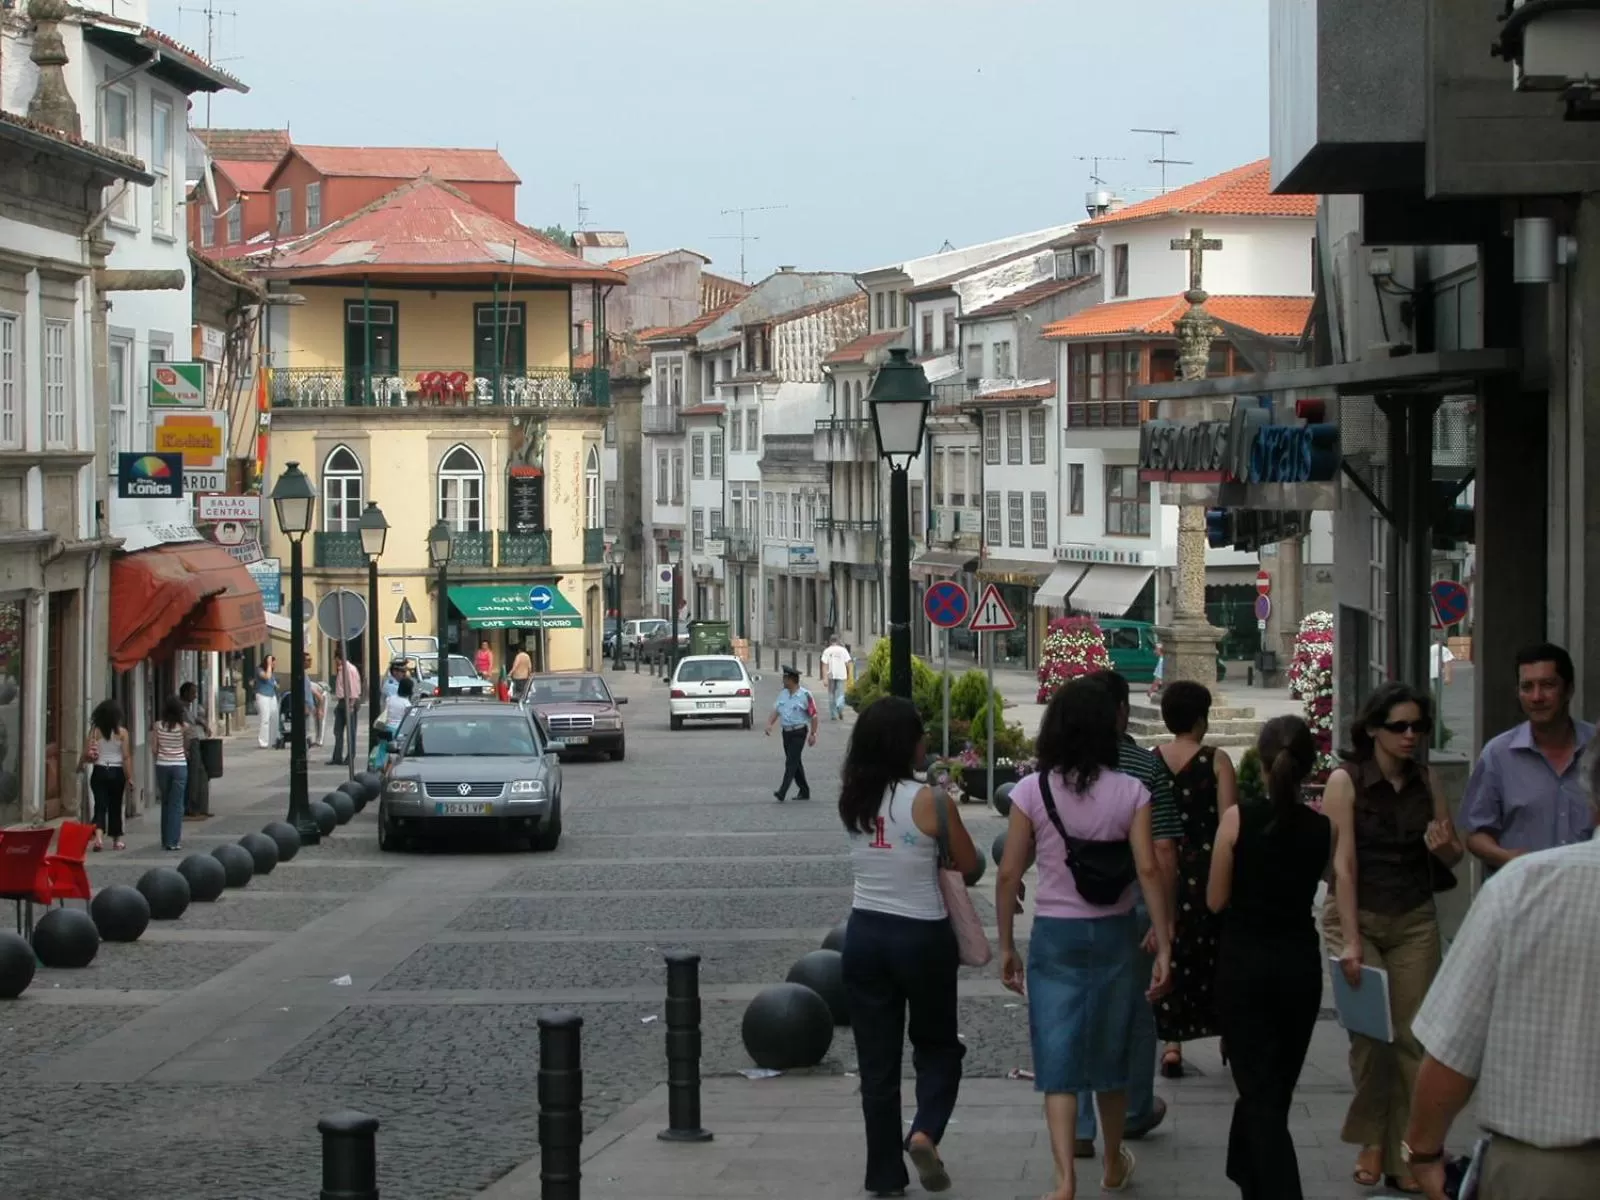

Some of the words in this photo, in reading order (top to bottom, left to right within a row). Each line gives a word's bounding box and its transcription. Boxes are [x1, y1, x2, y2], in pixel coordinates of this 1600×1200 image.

[127, 482, 172, 495] Konica
[206, 508, 254, 516] CENTRAL
[869, 816, 892, 849] 1
